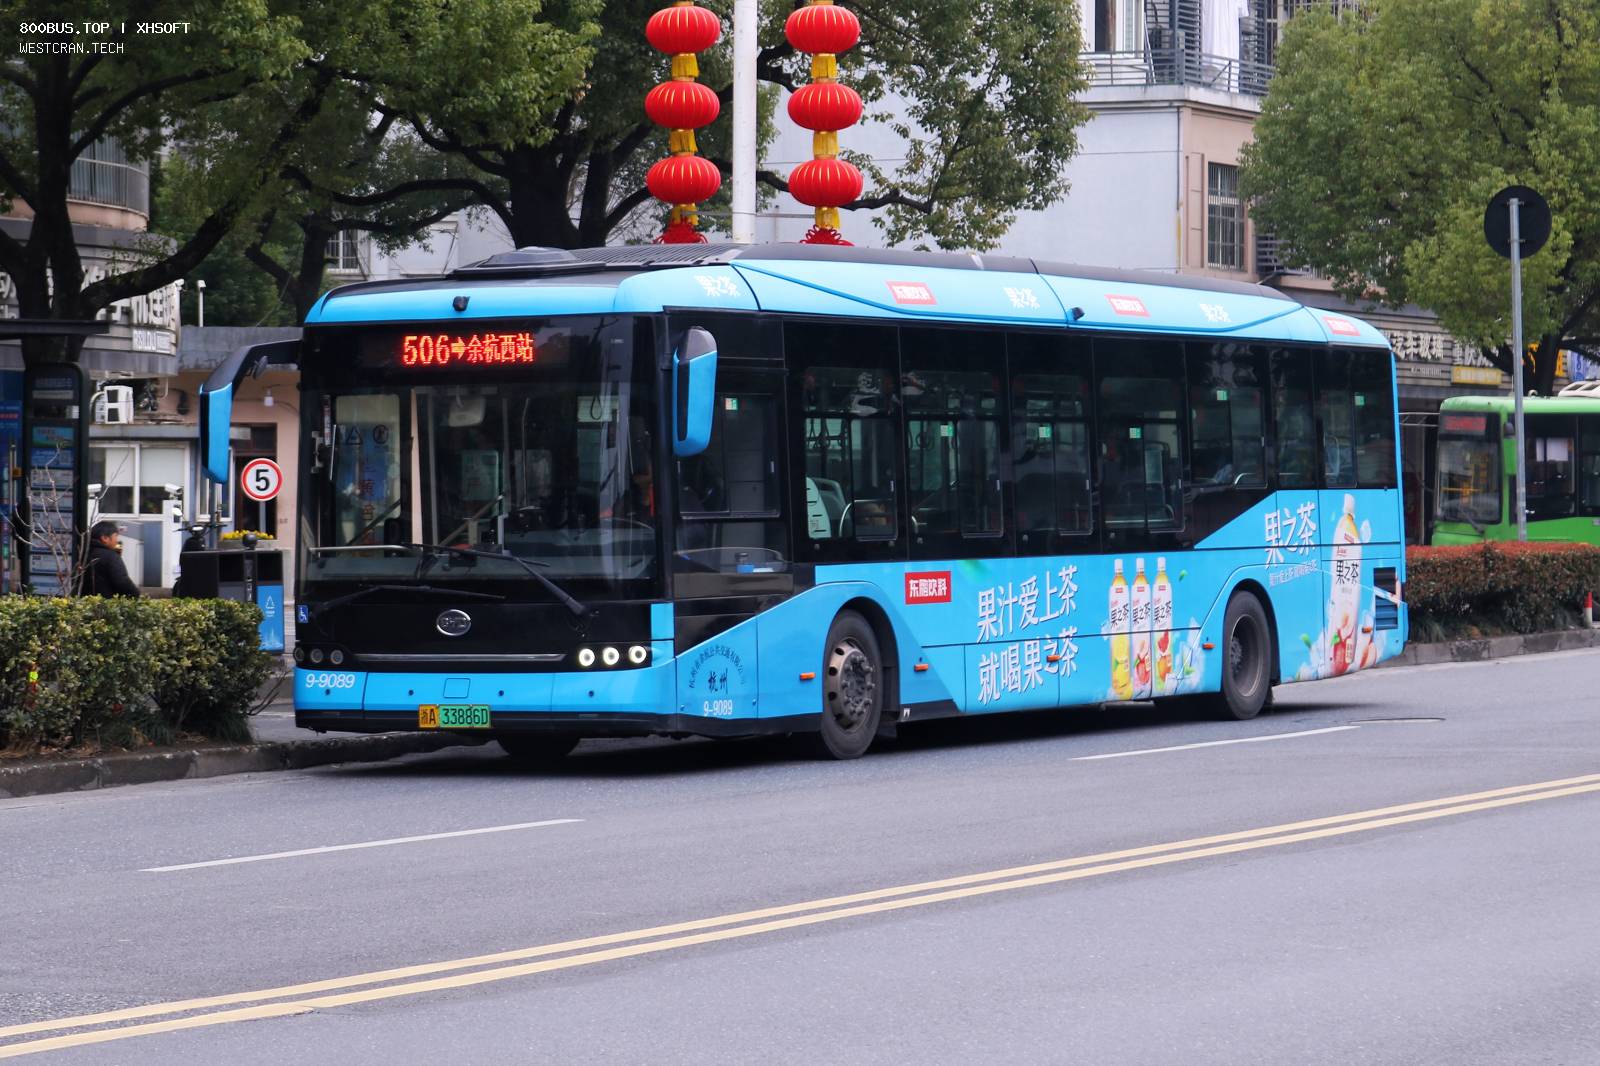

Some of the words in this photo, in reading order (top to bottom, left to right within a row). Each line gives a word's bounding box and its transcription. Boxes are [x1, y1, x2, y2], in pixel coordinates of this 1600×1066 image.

[403, 334, 450, 364] 506
[466, 332, 534, 363] 余杭西站
[254, 469, 270, 491] 5
[1264, 501, 1318, 569] 果之茶
[1336, 560, 1359, 585] 果之茶
[908, 577, 948, 598] 东鹏饮料
[976, 564, 1079, 644] 果汁爱上茶
[977, 625, 1080, 705] 就喝果之茶
[305, 673, 355, 689] 9-9089
[442, 707, 489, 726] 33886D
[703, 700, 733, 716] 9-9089
